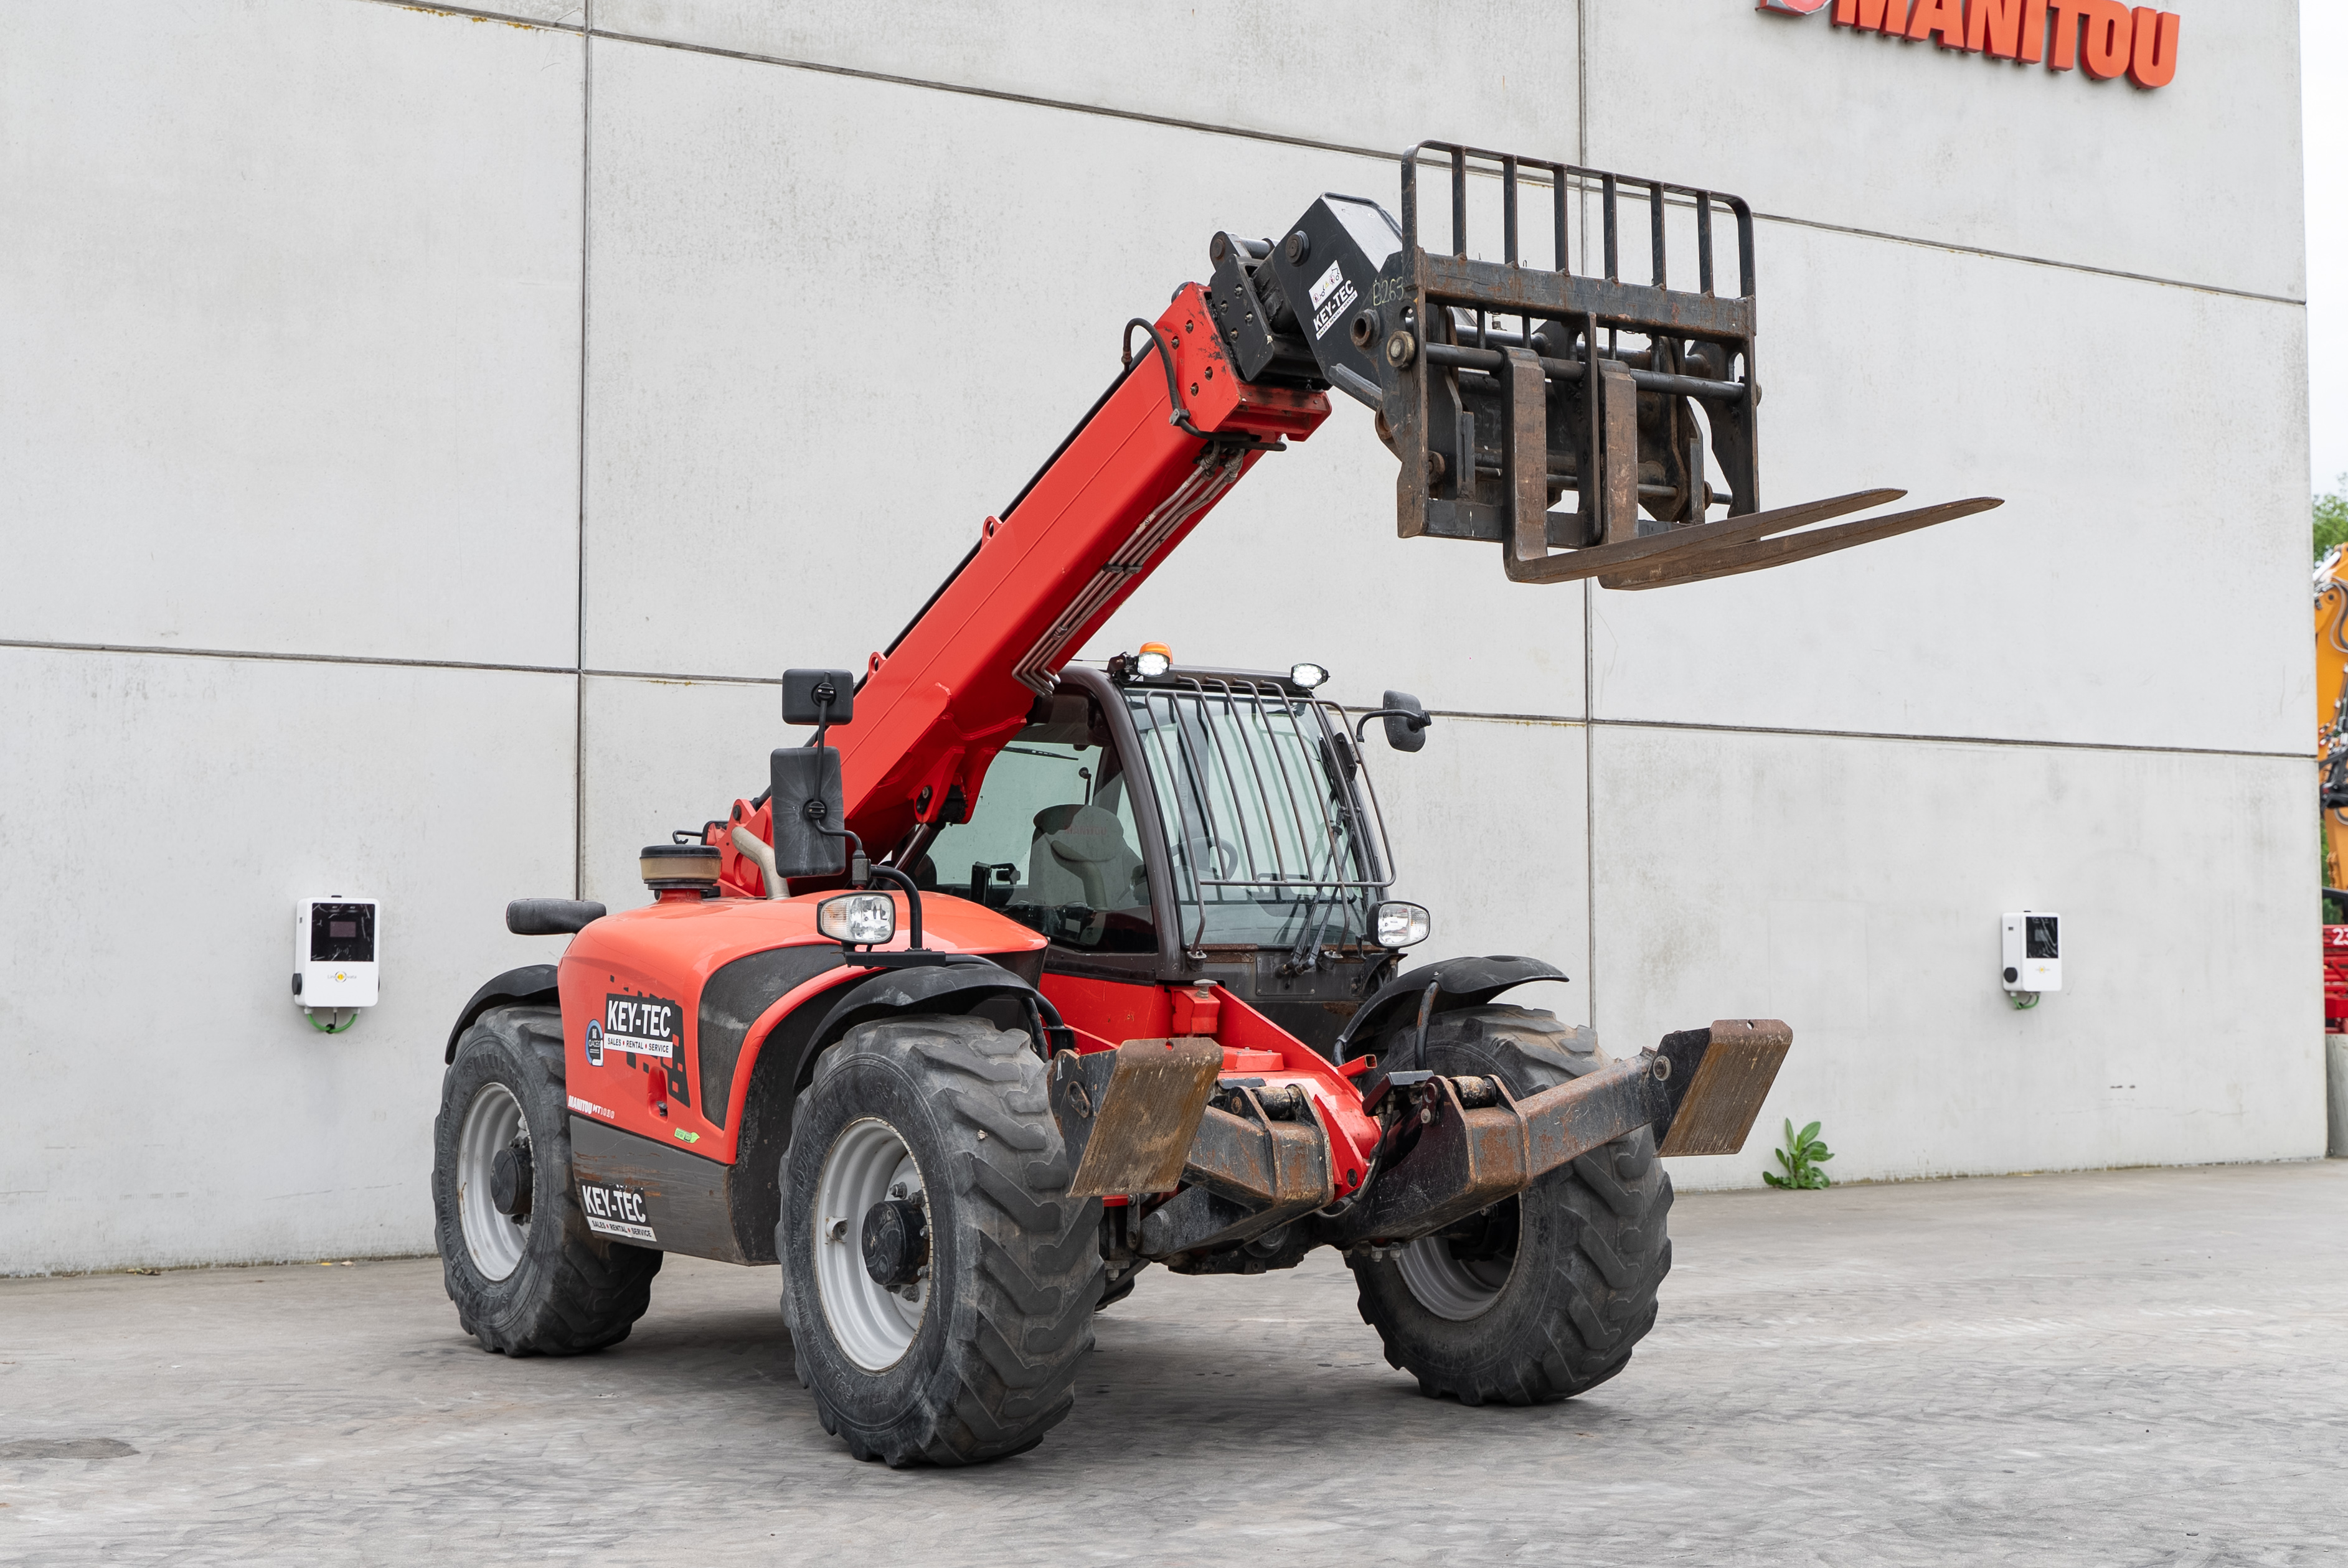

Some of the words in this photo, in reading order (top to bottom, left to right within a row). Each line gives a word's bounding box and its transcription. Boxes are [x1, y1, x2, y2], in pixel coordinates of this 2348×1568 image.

[1313, 279, 1354, 332] KEY-TEC
[1329, 311, 1342, 324] RENTAL
[1343, 293, 1356, 309] SERVICE
[607, 1000, 671, 1038] KEY-TEC
[608, 1037, 621, 1046] SALES
[626, 1040, 644, 1049] RENTAL
[649, 1043, 669, 1053] SERVICE
[568, 1095, 593, 1115] MANITOU
[582, 1185, 646, 1223] KEY-TEC
[592, 1220, 606, 1229] SALES
[610, 1224, 628, 1233] RENTAL
[631, 1228, 652, 1237] SERVICE
